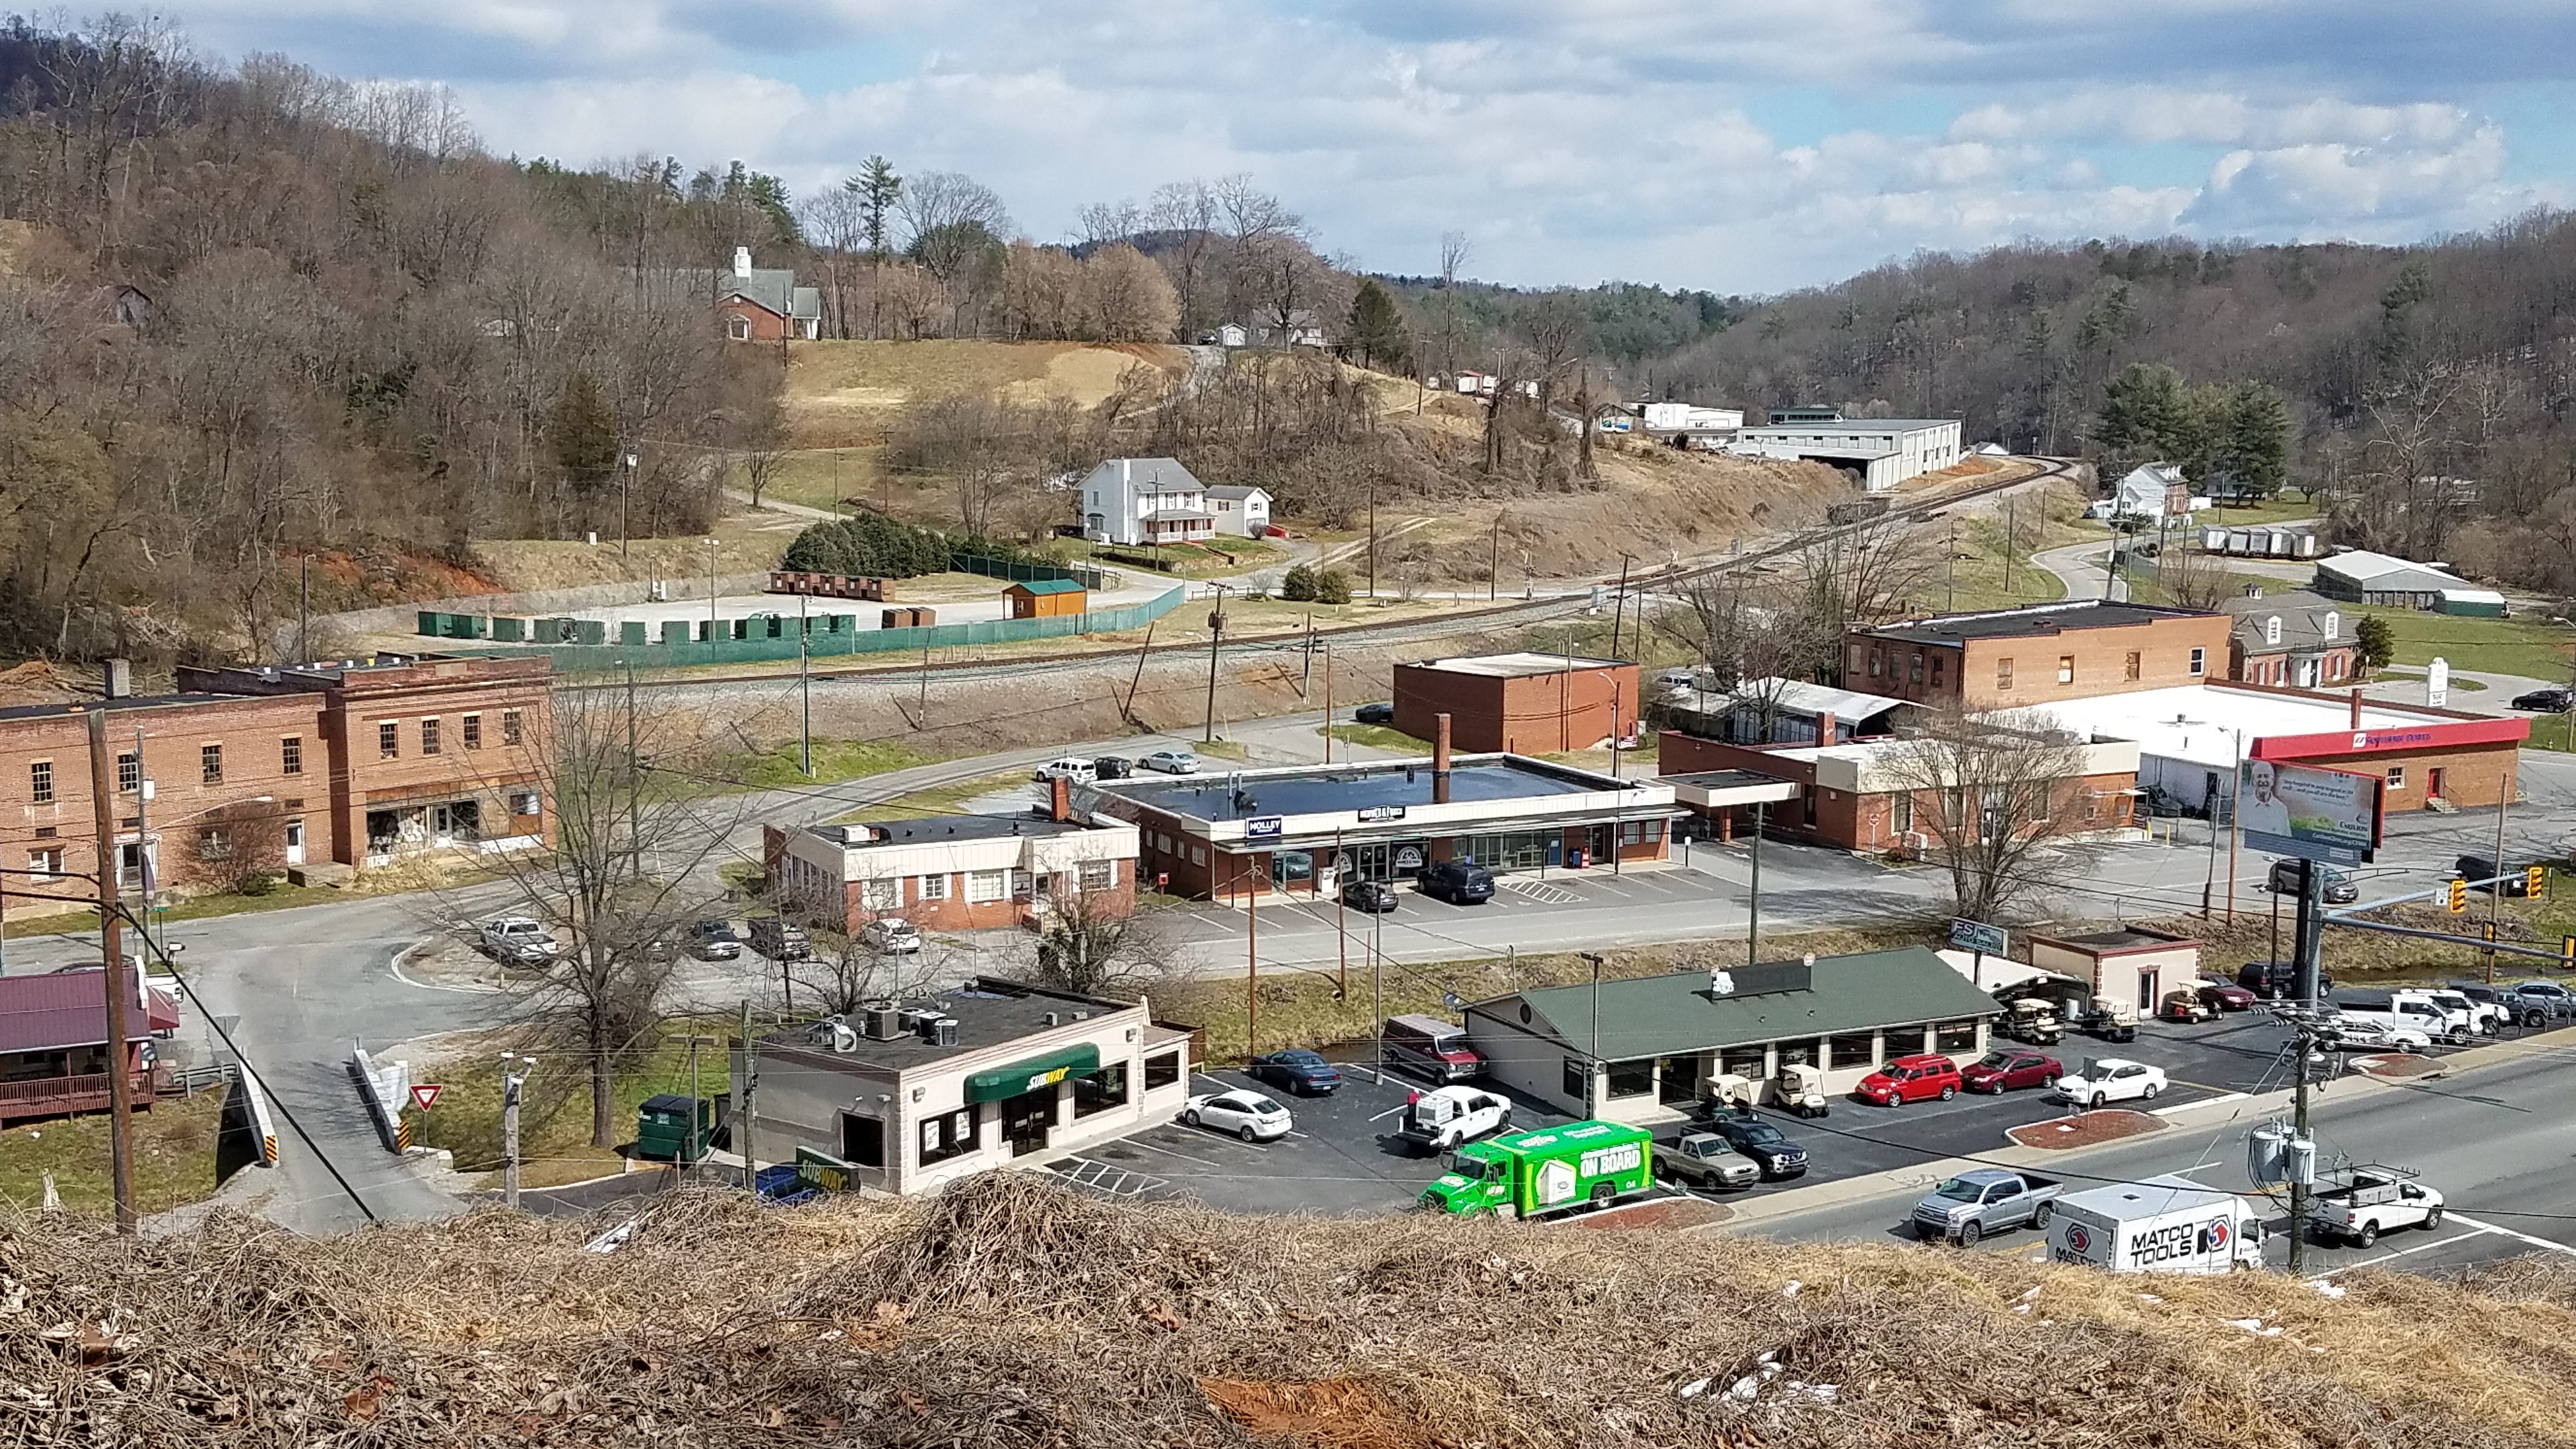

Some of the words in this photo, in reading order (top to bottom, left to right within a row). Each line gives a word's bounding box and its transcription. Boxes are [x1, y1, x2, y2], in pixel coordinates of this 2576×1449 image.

[1954, 921, 1974, 935] FS
[1026, 1066, 1070, 1091] SUBWAY
[799, 1159, 848, 1192] SUBWAY
[1581, 1157, 1598, 1177] ON
[1600, 1150, 1641, 1174] BOARD
[2132, 1223, 2193, 1250] MATCO
[2131, 1239, 2191, 1267] TOOLS
